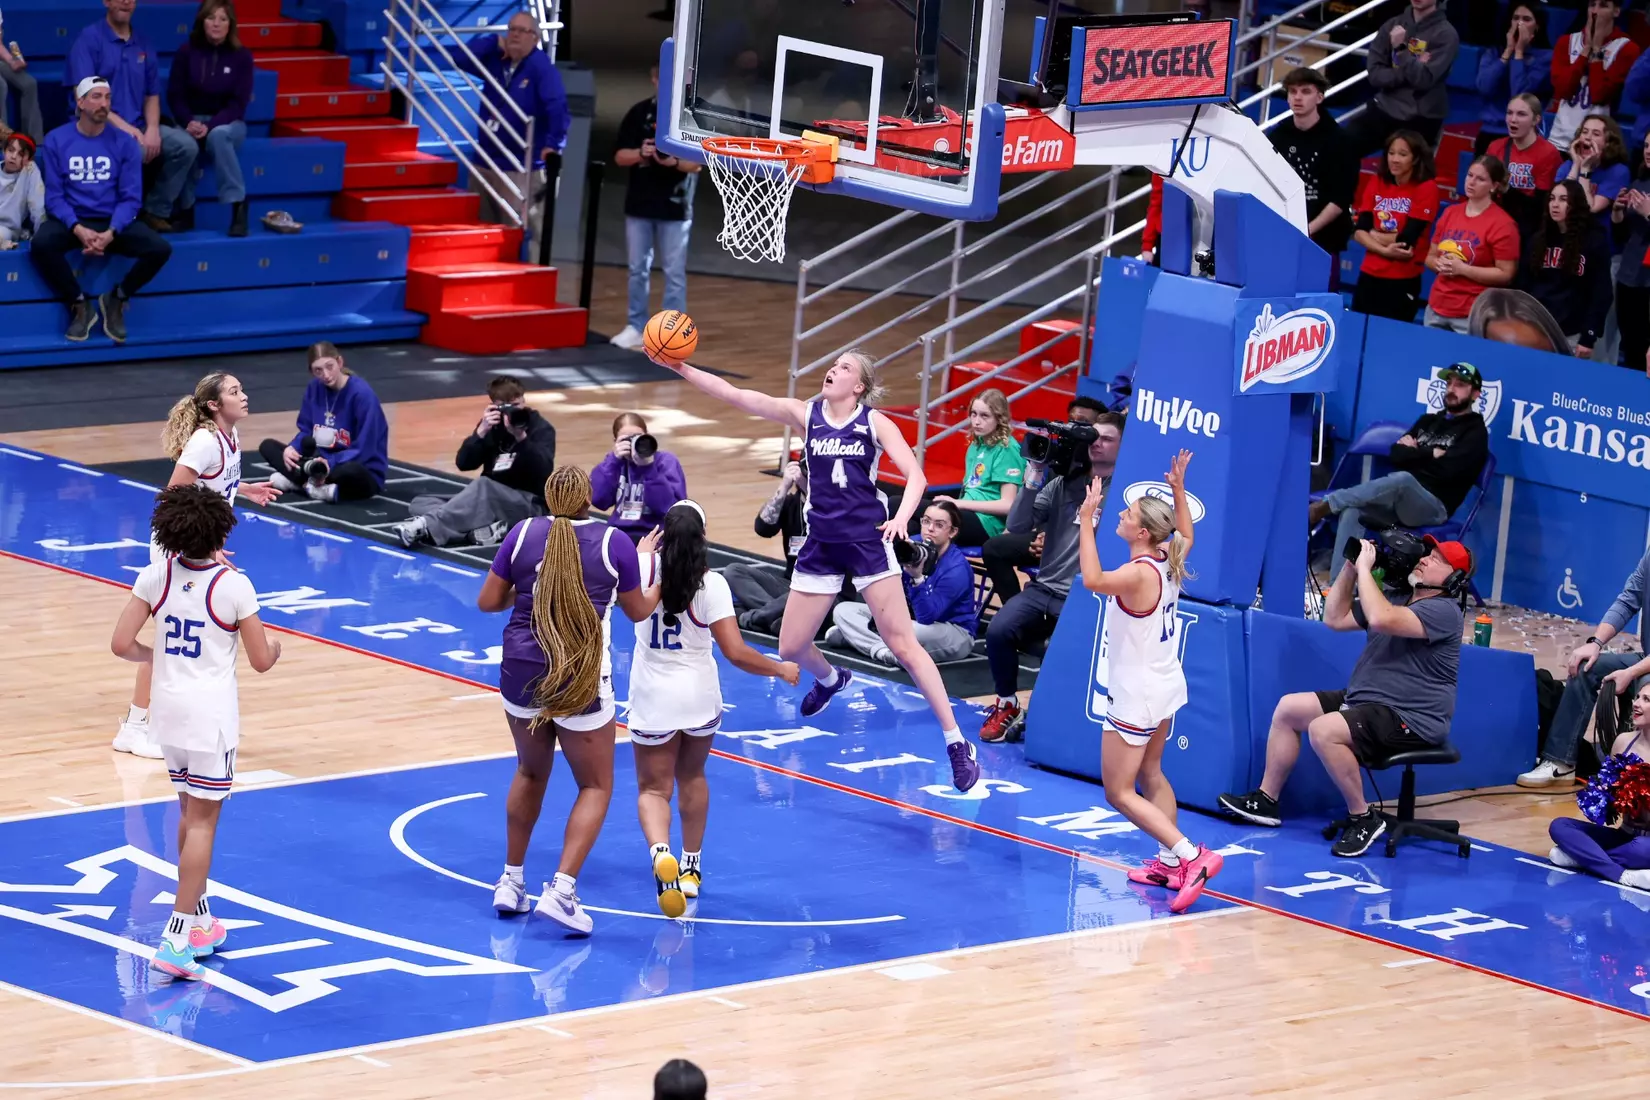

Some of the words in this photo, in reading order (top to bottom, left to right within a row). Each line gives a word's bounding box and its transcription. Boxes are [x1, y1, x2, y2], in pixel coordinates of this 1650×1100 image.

[1092, 40, 1218, 85] SEATGEEK
[680, 131, 711, 143] SPALDI
[1169, 135, 1213, 178] KU
[1507, 161, 1534, 178] OCK
[1507, 174, 1536, 190] ALK
[1243, 322, 1326, 383] LIBMAN
[1552, 391, 1613, 418] BlueCross
[810, 437, 866, 456] Wildcats
[831, 458, 848, 488] 4
[1580, 492, 1588, 503] 5
[164, 614, 206, 659] 25
[649, 612, 684, 651] 12
[612, 700, 1529, 941] AISMTH
